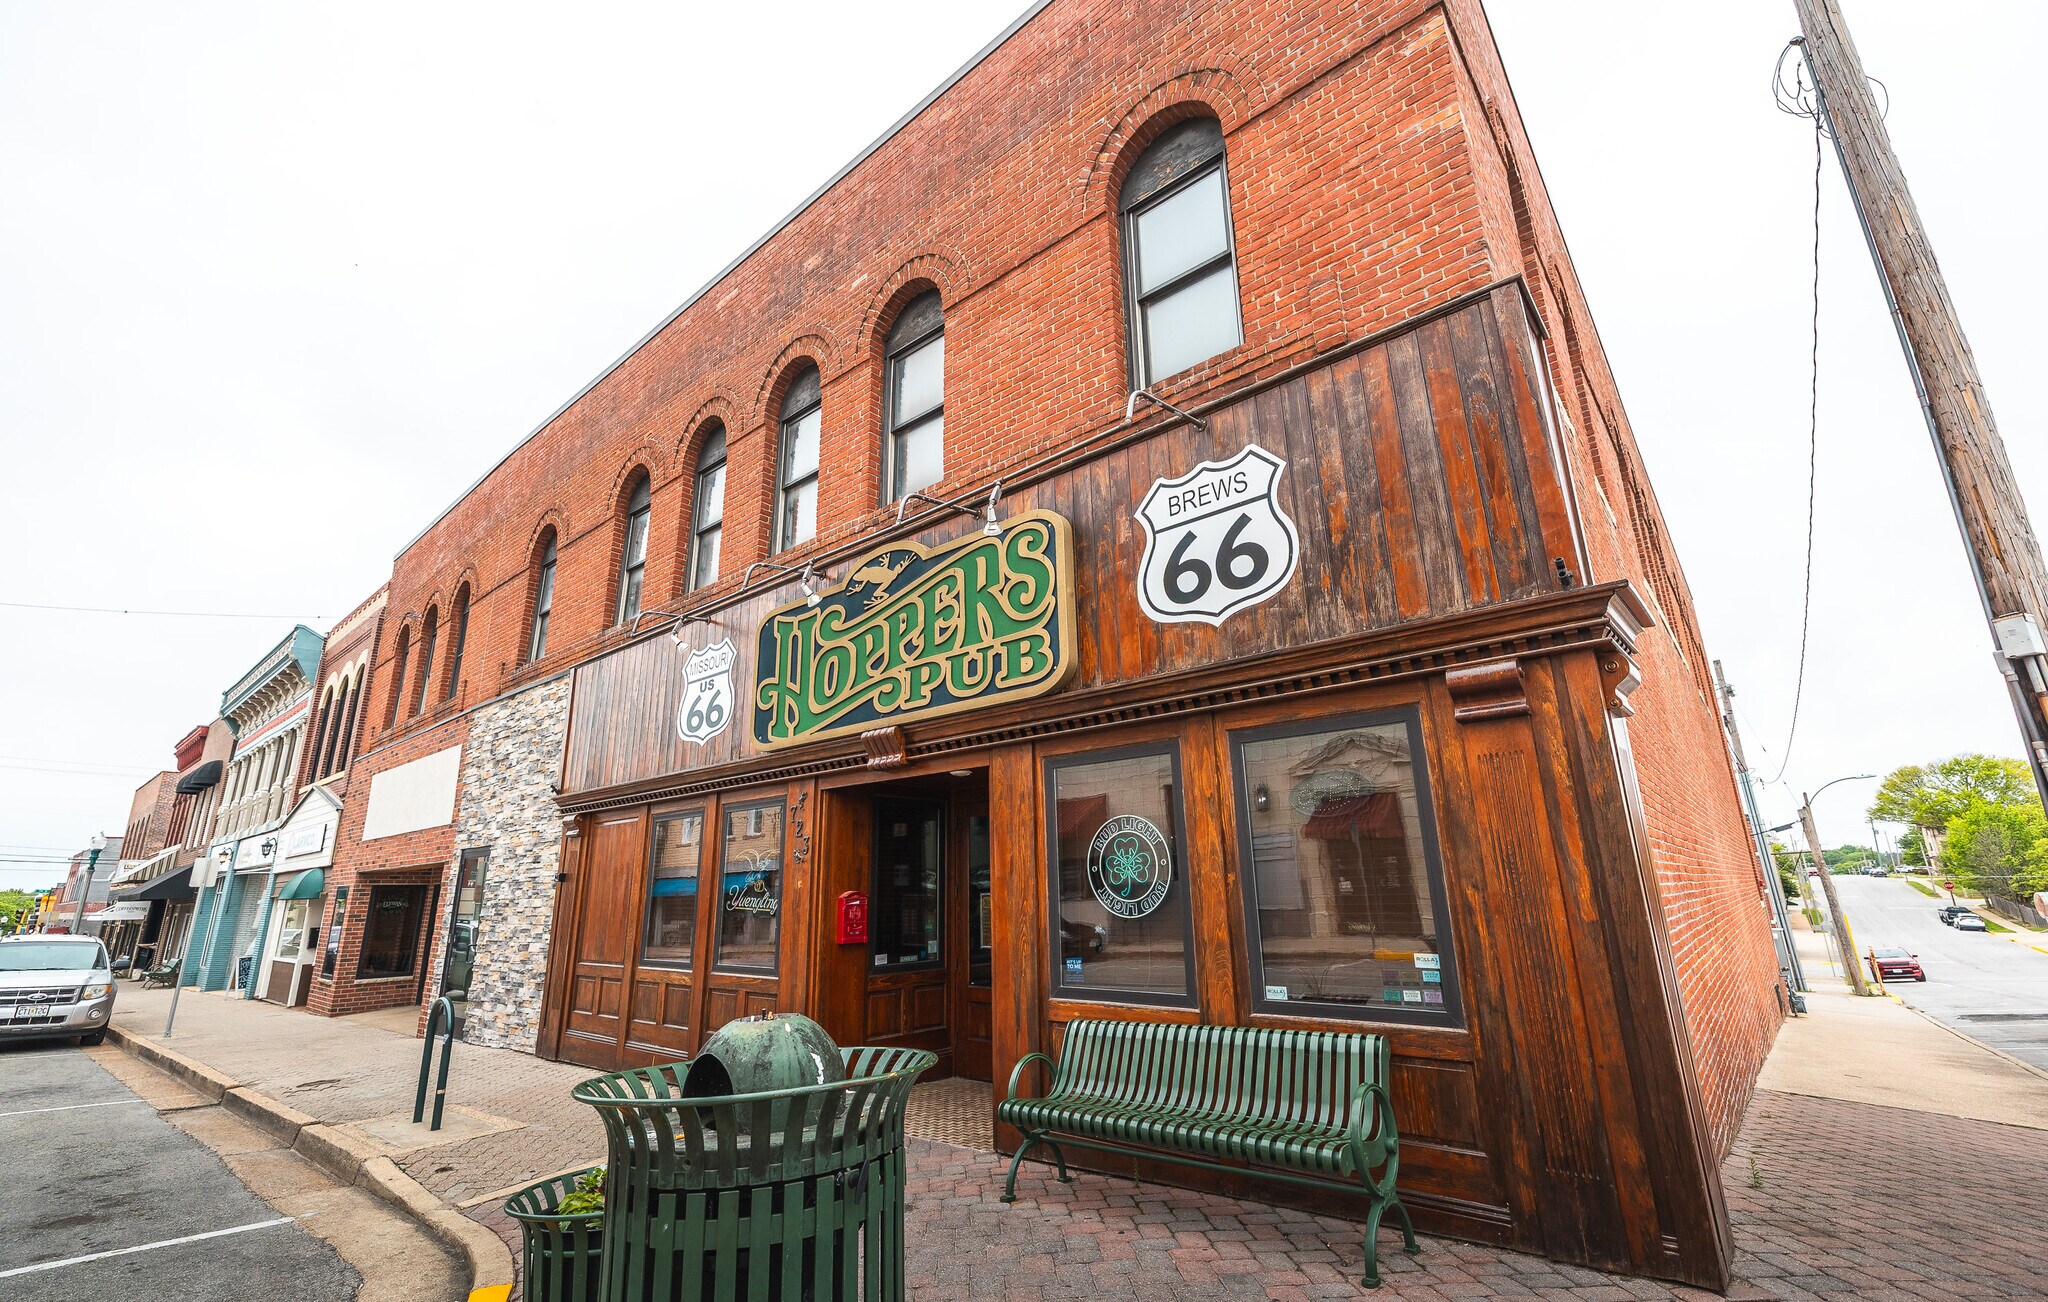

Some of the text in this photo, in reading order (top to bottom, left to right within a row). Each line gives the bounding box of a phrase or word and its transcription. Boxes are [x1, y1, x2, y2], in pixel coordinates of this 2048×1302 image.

[1168, 471, 1248, 517] BREWS
[1163, 512, 1269, 604] 66
[758, 522, 1056, 741] HOPPERS
[689, 651, 730, 676] MISSOURI
[877, 632, 1053, 711] PUB
[700, 679, 715, 693] US
[686, 689, 724, 733] 66
[1298, 780, 1360, 806] OPEN
[790, 805, 810, 855] 723
[1094, 818, 1162, 852] BUD LIGHT
[726, 885, 779, 915] Yuengling
